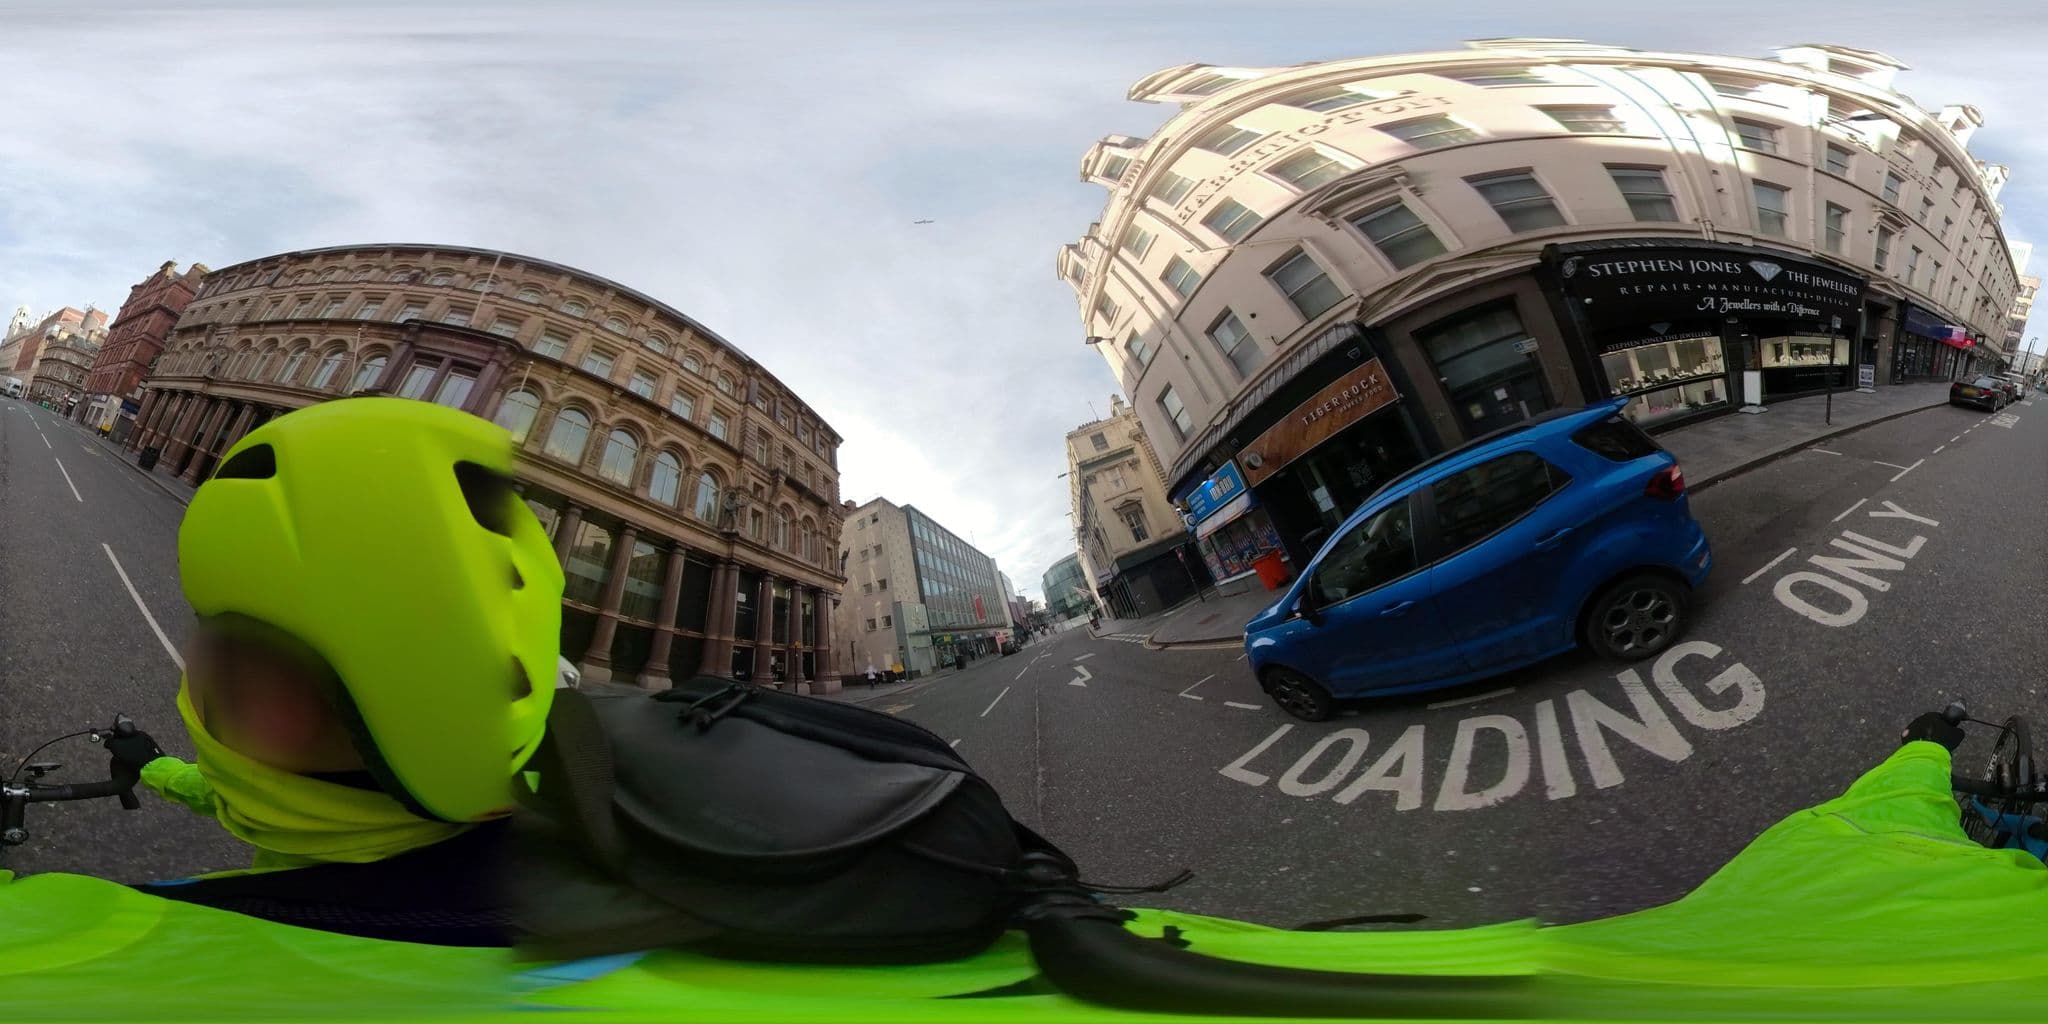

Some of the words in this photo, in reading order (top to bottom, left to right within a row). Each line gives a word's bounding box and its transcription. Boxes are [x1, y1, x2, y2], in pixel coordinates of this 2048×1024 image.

[1588, 259, 1684, 277] STEPHEN
[1689, 259, 1742, 274] JONES
[1786, 270, 1810, 284] THE
[1811, 276, 1859, 296] JEWELLERS
[1619, 283, 1691, 296] REPAIR
[1708, 283, 1808, 299] MANUFACTURE
[1697, 296, 1715, 311] A
[1719, 297, 1761, 313] Jewellers
[1763, 301, 1780, 312] with
[1787, 302, 1820, 317] Difference
[1606, 340, 1641, 351] STEPHEN
[1641, 336, 1664, 346] JONES
[1302, 397, 1341, 425] TIGER
[1342, 374, 1379, 400] ROCK
[1219, 640, 1766, 811] LOADING
[1773, 499, 1940, 627] ONLY
